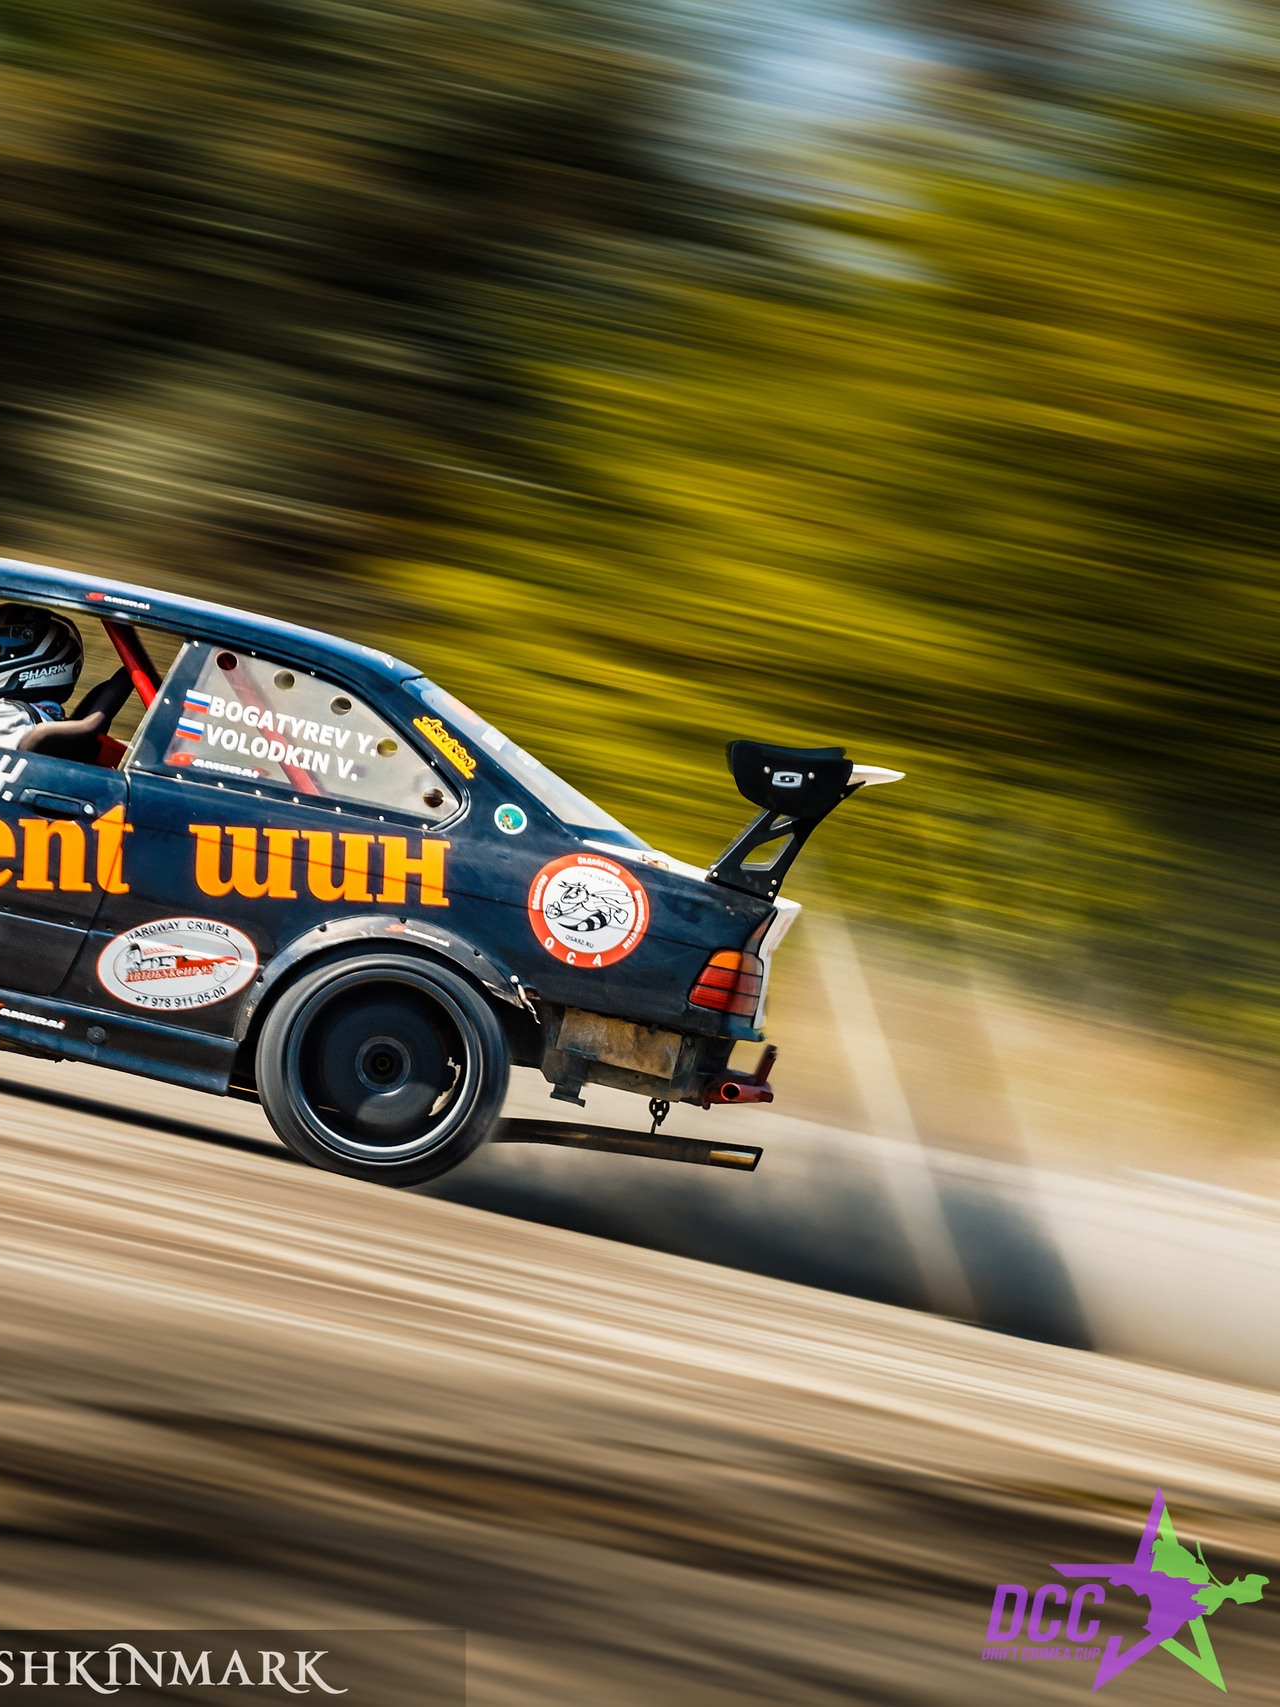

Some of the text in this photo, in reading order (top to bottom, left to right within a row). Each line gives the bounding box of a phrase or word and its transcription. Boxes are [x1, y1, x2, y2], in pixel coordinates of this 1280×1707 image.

[18, 663, 66, 681] SHARK
[209, 696, 377, 757] BOGATYREV Y.
[206, 724, 358, 782] VOLODKIN V.
[126, 920, 230, 942] HARDWAY CRIMEA
[135, 986, 227, 1008] +7 978 911-05-00
